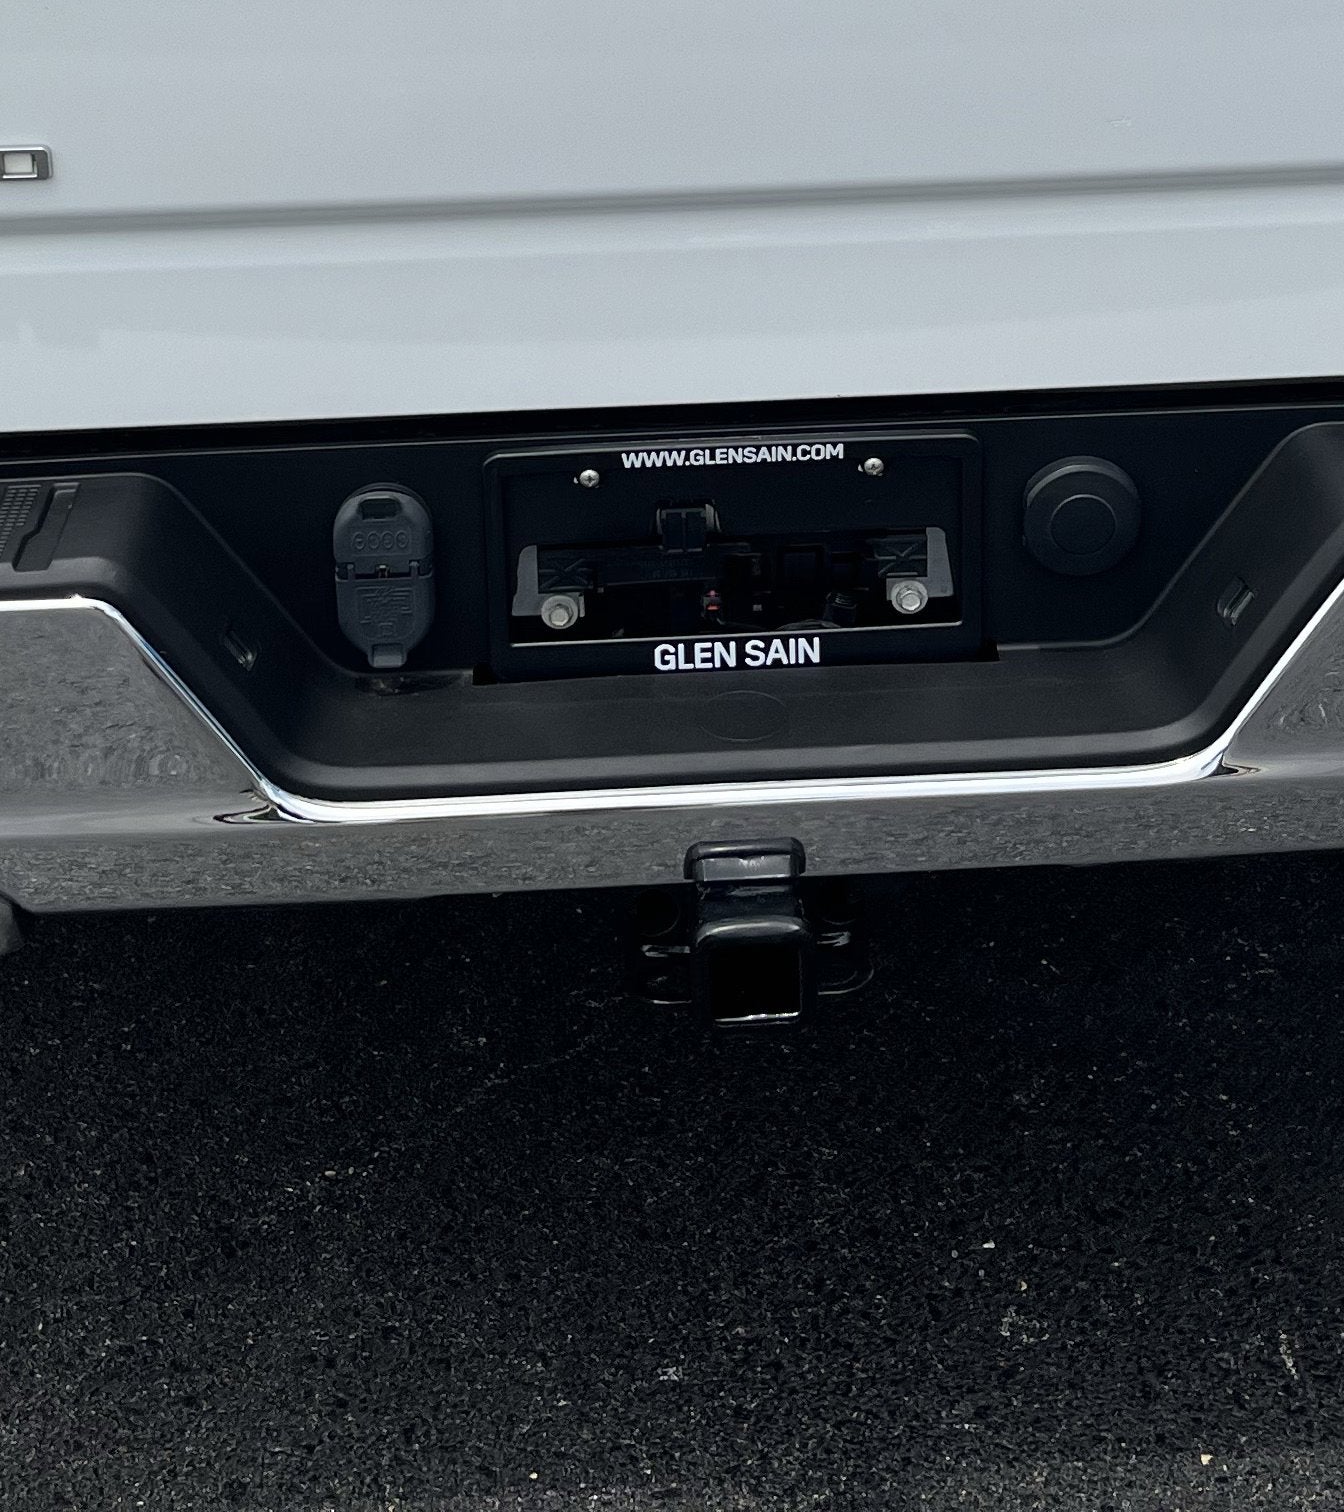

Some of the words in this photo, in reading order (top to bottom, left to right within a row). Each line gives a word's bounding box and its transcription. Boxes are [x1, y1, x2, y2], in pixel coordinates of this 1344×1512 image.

[620, 443, 844, 469] WWW.GLENSAIN.COM
[654, 641, 737, 671] GLEN
[744, 636, 821, 667] SAIN
